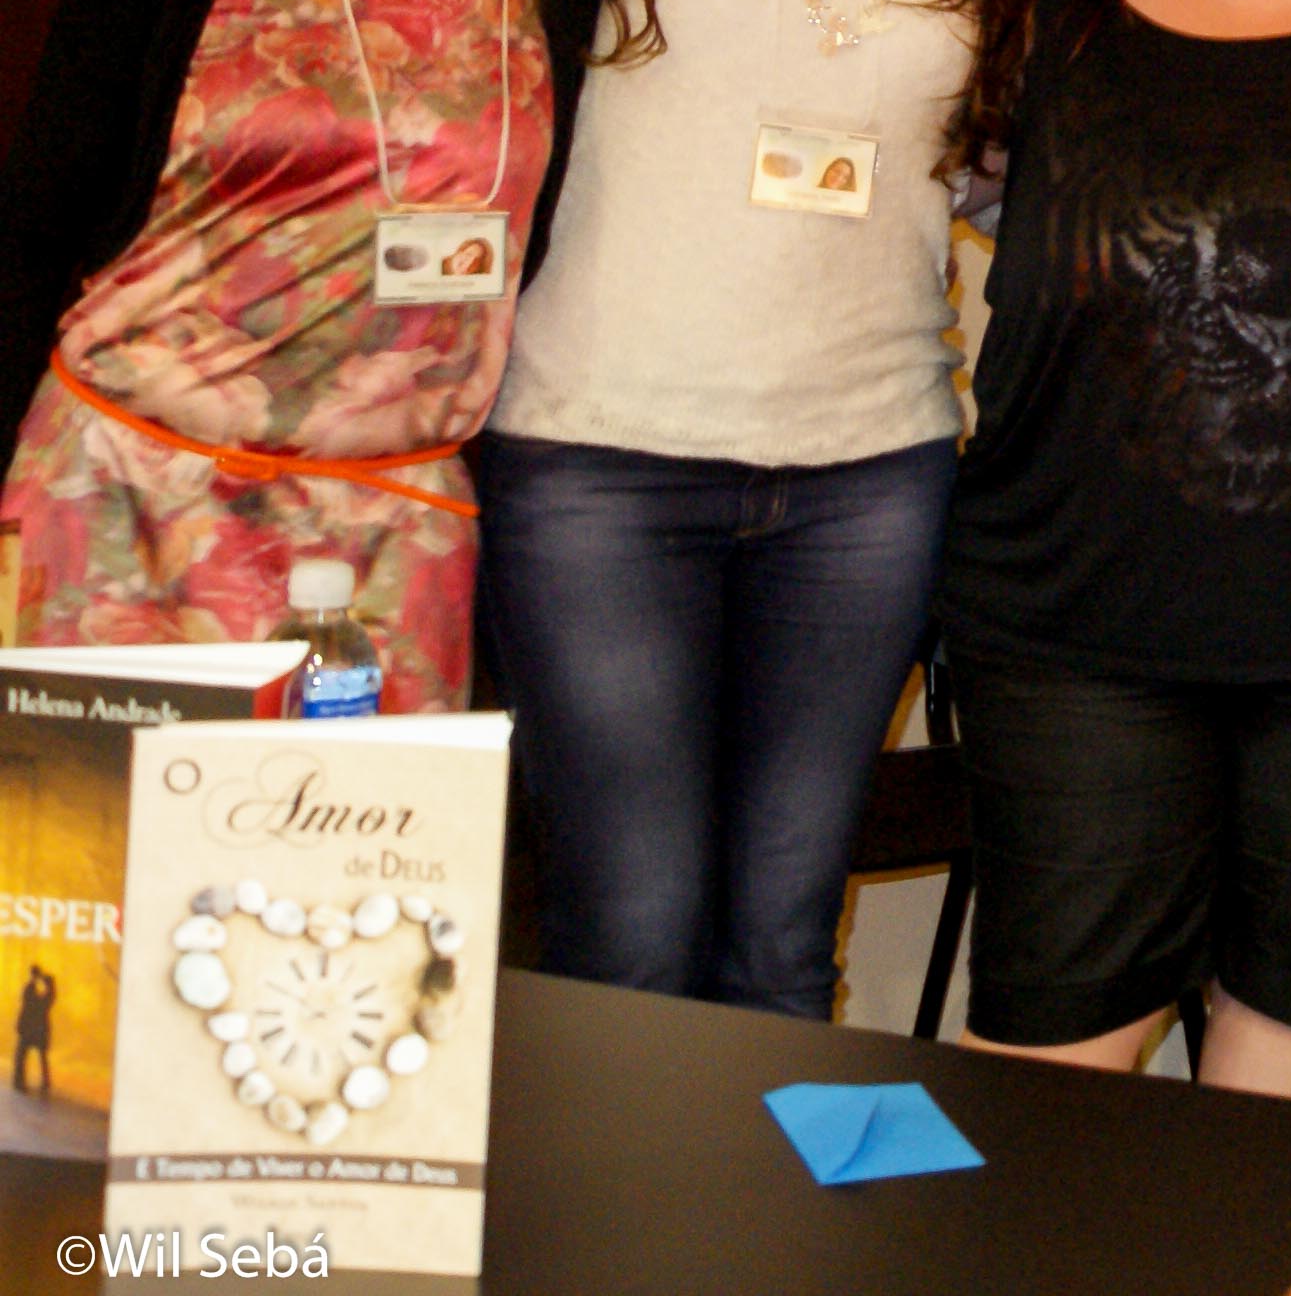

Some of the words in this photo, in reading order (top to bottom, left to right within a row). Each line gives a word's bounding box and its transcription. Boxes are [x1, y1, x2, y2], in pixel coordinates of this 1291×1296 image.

[7, 687, 85, 719] Helena
[163, 757, 202, 795] O
[203, 754, 423, 847] Amor
[344, 854, 373, 877] de
[326, 1157, 381, 1180] Amor
[411, 1160, 459, 1186] Deus
